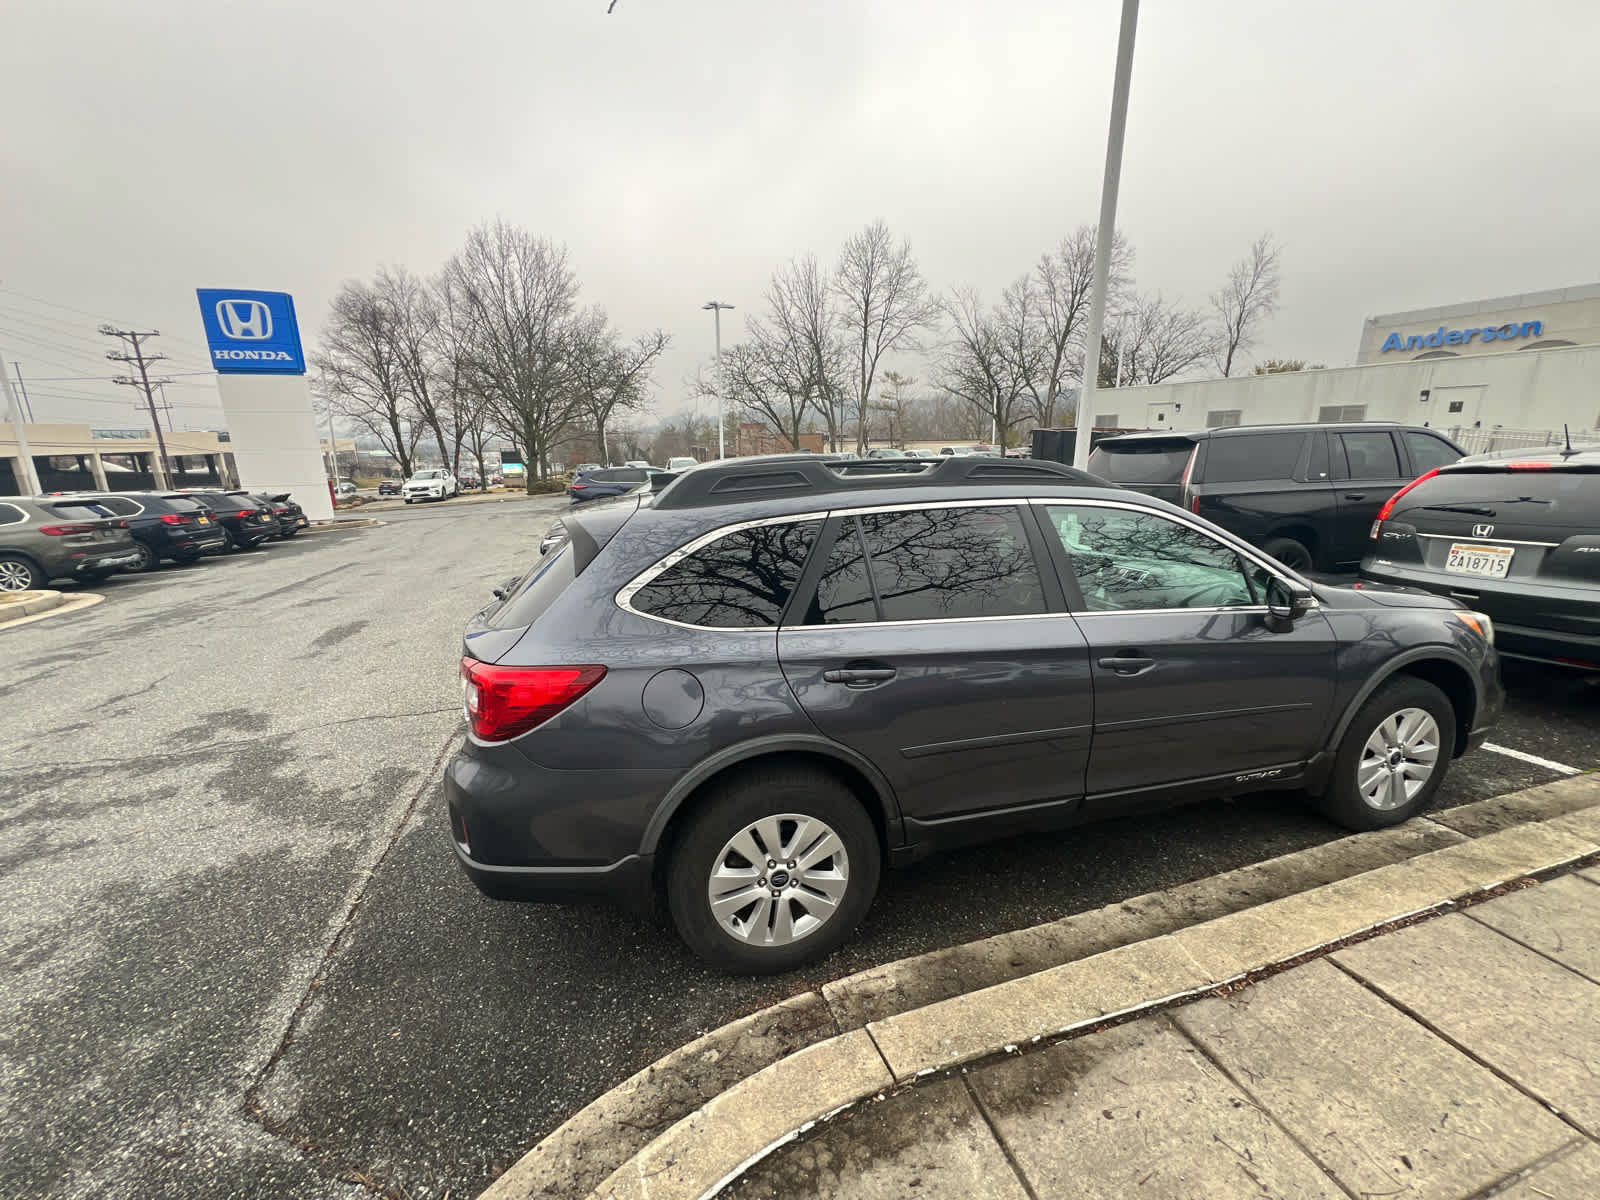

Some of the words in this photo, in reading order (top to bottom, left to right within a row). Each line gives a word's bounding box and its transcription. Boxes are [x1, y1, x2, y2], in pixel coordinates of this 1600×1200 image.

[1380, 320, 1543, 352] Anderson
[213, 350, 293, 361] HONDA
[1449, 555, 1506, 572] 2A18715
